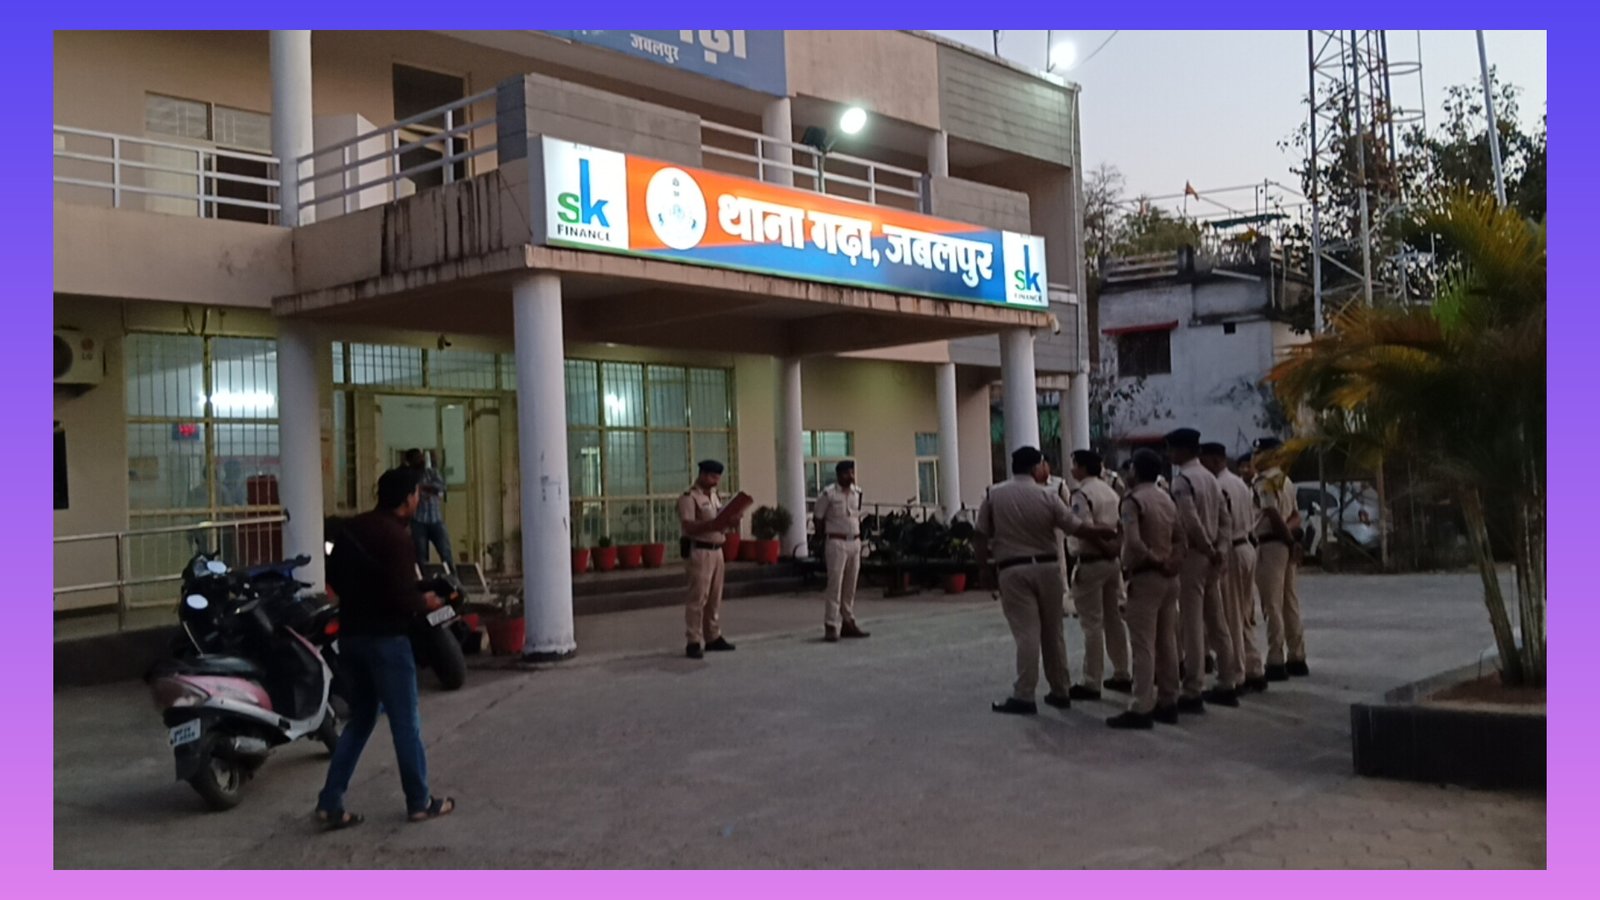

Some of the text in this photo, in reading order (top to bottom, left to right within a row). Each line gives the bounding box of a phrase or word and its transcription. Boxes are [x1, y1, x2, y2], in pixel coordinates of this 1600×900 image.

[629, 33, 680, 63] जबलपुर
[718, 194, 994, 288] थाना गढ़ा, जबलपुर
